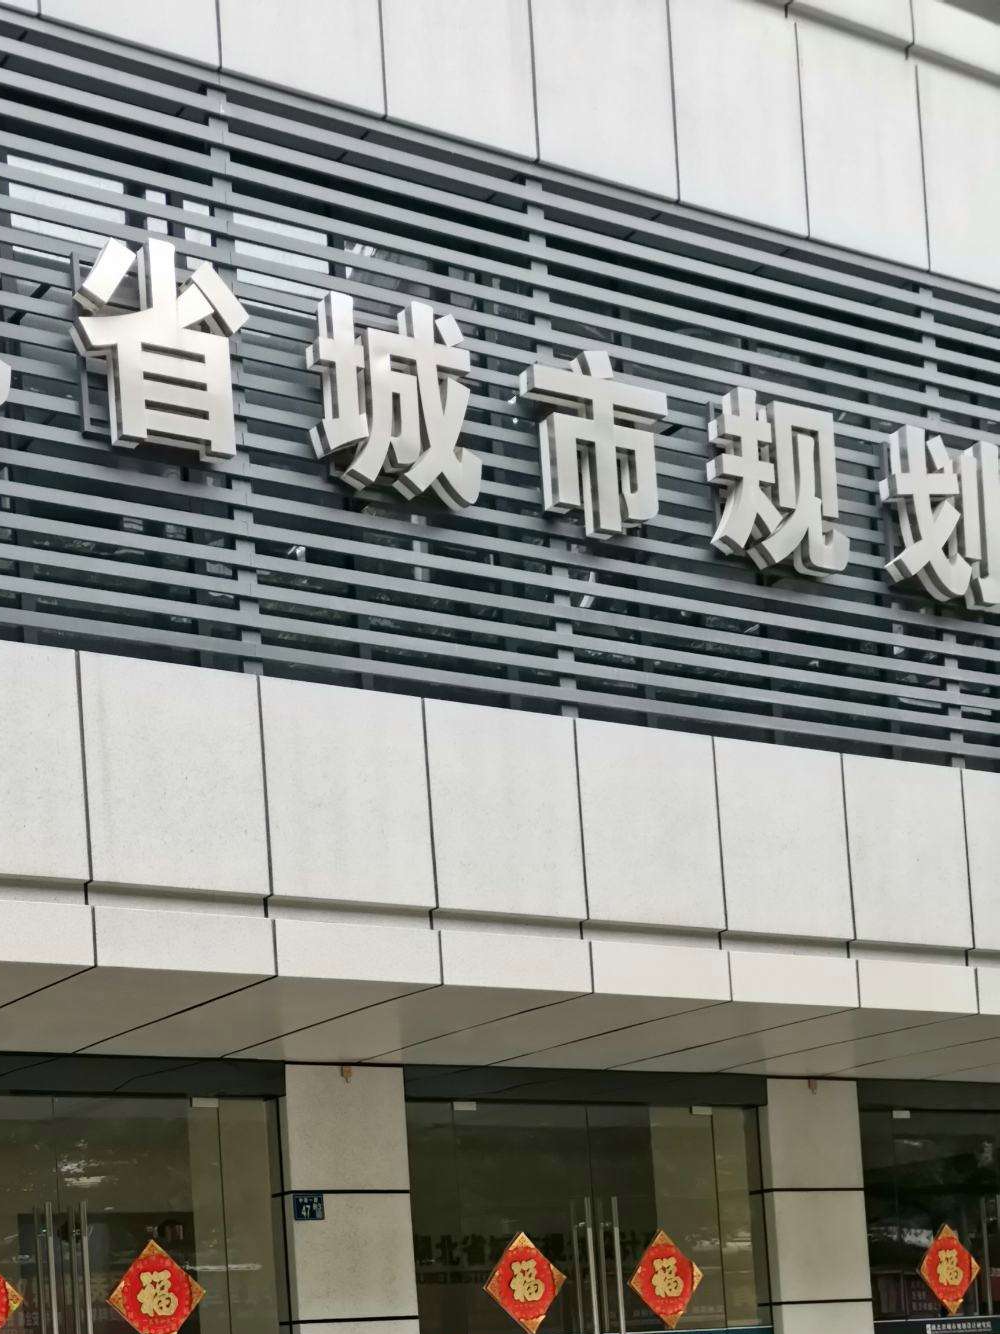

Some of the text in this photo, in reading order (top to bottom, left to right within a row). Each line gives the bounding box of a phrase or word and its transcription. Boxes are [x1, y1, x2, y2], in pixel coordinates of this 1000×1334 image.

[510, 1258, 545, 1303] 福
[651, 1256, 684, 1298] 福
[937, 1249, 964, 1286] 福
[137, 1269, 179, 1317] 福
